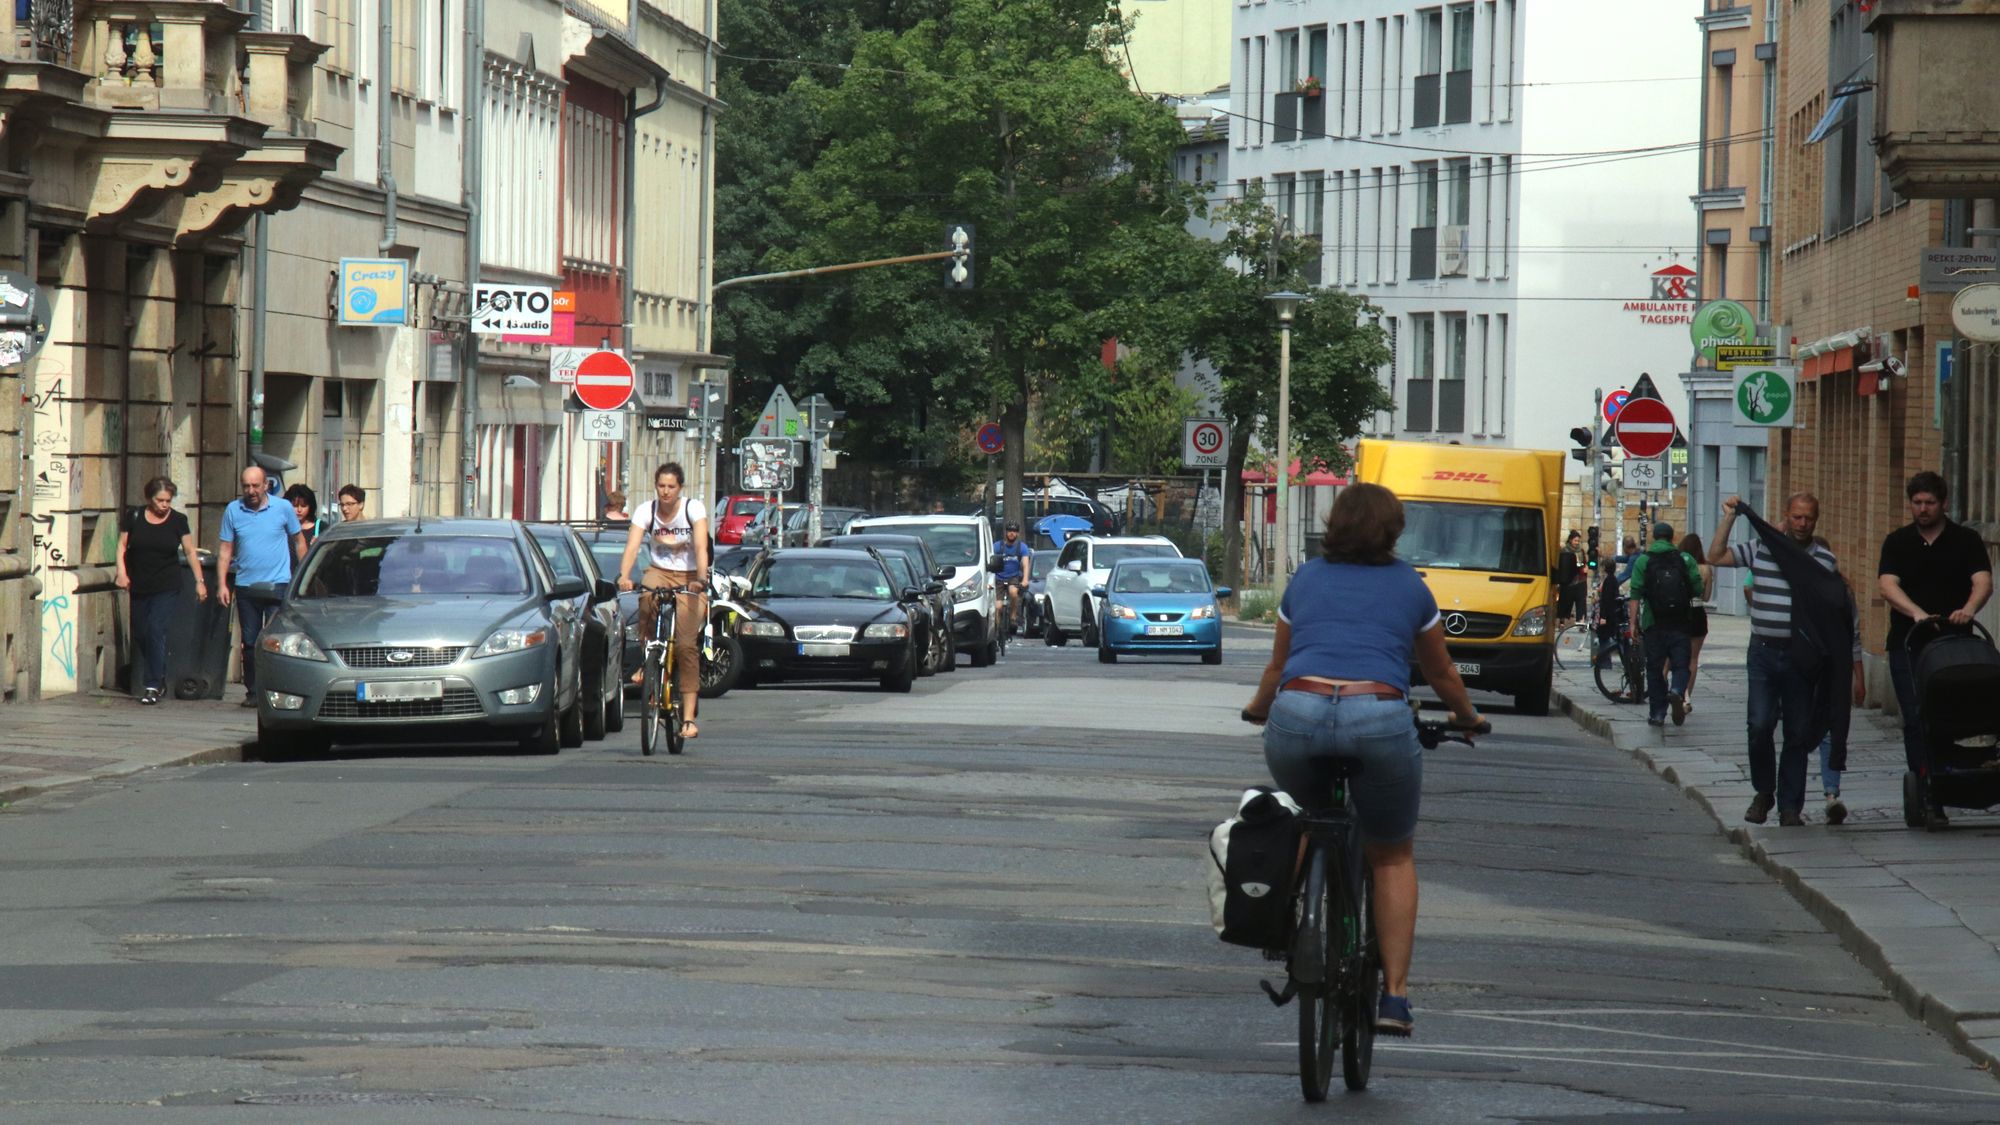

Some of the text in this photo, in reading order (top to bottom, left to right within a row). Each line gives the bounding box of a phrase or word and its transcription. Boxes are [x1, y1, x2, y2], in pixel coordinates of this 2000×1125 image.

[351, 269, 396, 282] Crazy
[476, 289, 549, 314] FOTO
[1622, 302, 1690, 312] AMBULANTE
[1719, 349, 1764, 357] WESTERN
[647, 418, 687, 429] NGELSTU
[596, 430, 612, 438] frei
[1199, 432, 1216, 446] 30
[1195, 455, 1218, 464] ZONE
[1432, 470, 1491, 483] DHL
[1460, 664, 1480, 674] 5043
